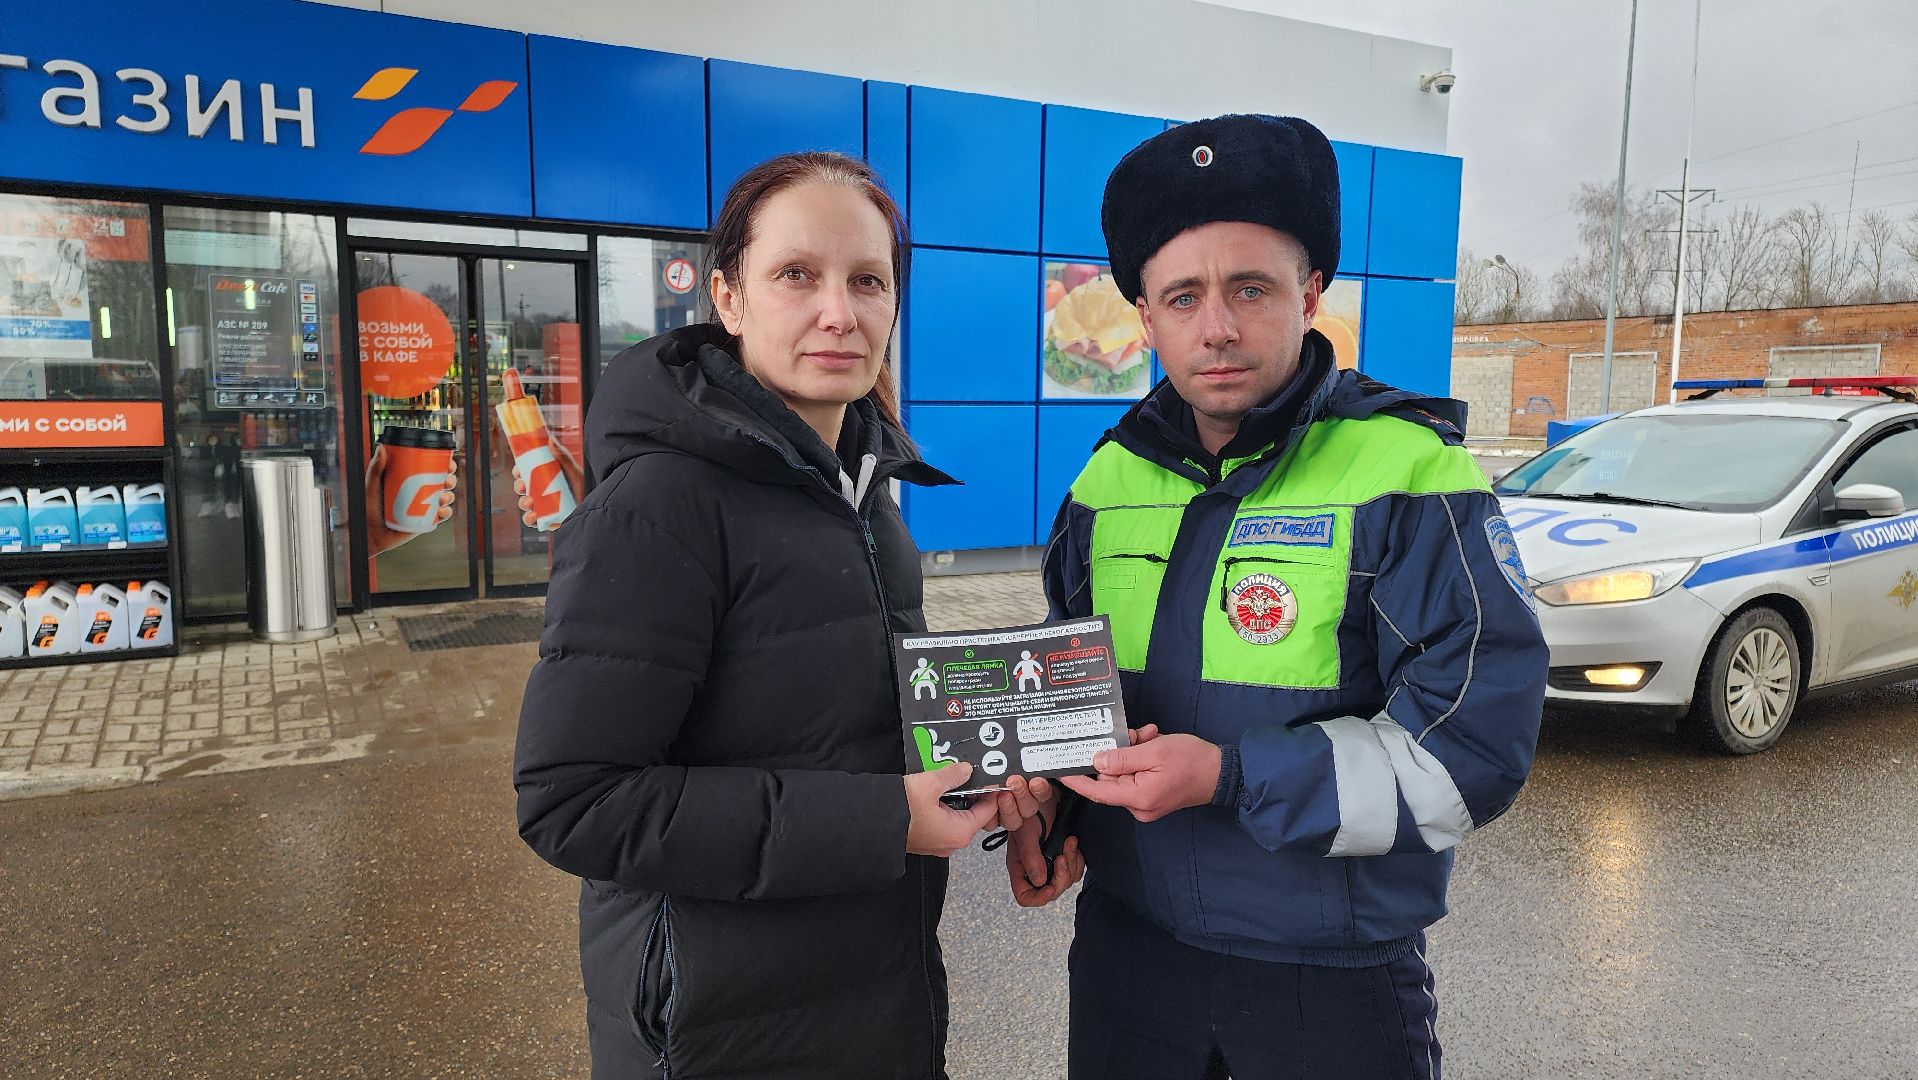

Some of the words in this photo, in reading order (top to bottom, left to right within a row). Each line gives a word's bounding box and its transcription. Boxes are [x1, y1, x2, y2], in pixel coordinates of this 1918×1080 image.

[260, 281, 289, 294] Cafe
[358, 321, 424, 335] ВОЗЬМИ
[359, 336, 369, 348] С
[373, 332, 433, 349] СОБОЙ
[359, 350, 369, 362] В
[373, 351, 418, 362] КАФЕ
[34, 418, 50, 432] С
[55, 414, 127, 432] СОБОЙ
[1237, 522, 1270, 539] ДПС
[1270, 521, 1326, 538] ГИБДД
[1233, 574, 1288, 596] ПОЛИЦИЯ
[1248, 619, 1272, 630] ДПС
